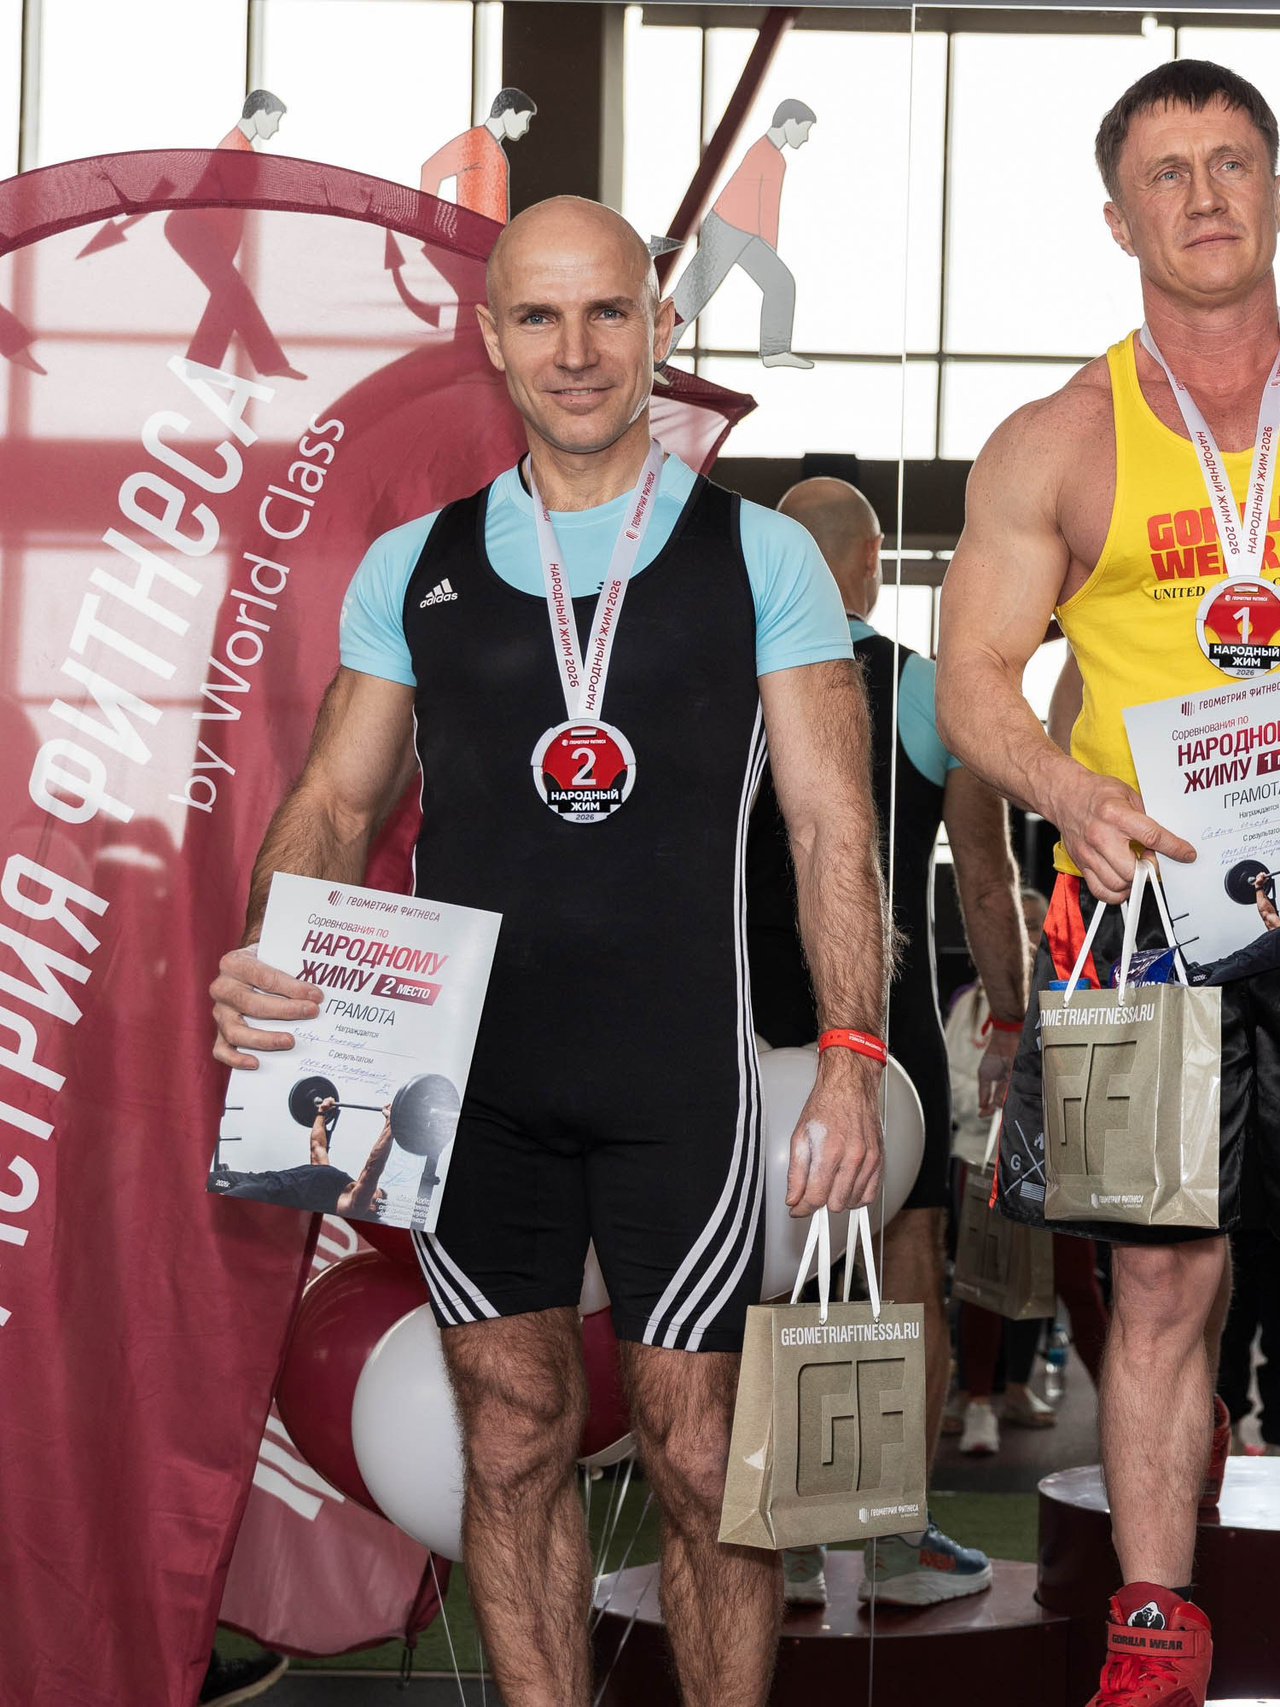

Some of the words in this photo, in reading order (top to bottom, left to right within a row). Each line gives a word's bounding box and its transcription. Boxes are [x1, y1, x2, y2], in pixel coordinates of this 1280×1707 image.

[1261, 426, 1273, 452] 2026
[257, 412, 345, 541] Class
[1257, 453, 1269, 482] ЖИМ
[1196, 431, 1226, 493] НАРОДНЫЙ
[1216, 495, 1233, 524] ЖИМ
[1225, 526, 1240, 555] 2026
[1247, 483, 1265, 554] НАРОДНЫЙ
[1150, 535, 1280, 581] WER
[420, 592, 458, 609] adidas
[549, 562, 570, 626] НАРОДНЫЙ
[1154, 585, 1206, 600] UNITED
[192, 552, 290, 721] World
[1232, 606, 1250, 644] 1
[559, 628, 574, 657] ЖИМ
[585, 638, 607, 711] НАРОДНЫЙ
[600, 607, 614, 637] ЖИМ
[607, 580, 622, 606] 2026
[1213, 645, 1280, 657] НАРОДНЫЙ
[565, 659, 580, 688] 2026
[1232, 657, 1260, 667] ЖИМ
[1171, 718, 1236, 741] Соревнования
[1237, 715, 1249, 727] по
[168, 740, 236, 813] by
[571, 747, 597, 786] 2
[1183, 756, 1252, 794] ЖИМУ
[1264, 756, 1273, 771] 1
[551, 788, 619, 802] НАРОДНЫЙ
[571, 802, 600, 811] ЖИМ
[1238, 803, 1280, 819] Награждается
[307, 913, 375, 936] Соревнования
[376, 927, 389, 938] по
[301, 930, 450, 976] НАРОДНОМУ
[296, 959, 375, 993] ЖИМУ
[380, 977, 397, 995] 2
[396, 983, 431, 999] МЕСТО
[325, 999, 396, 1026] ГРАМОТА
[335, 1024, 380, 1039] Награждается
[334, 1051, 375, 1064] результатом
[1010, 1154, 1022, 1171] G
[781, 1322, 920, 1346] GEOMETRIAFITNESSA.RU
[1111, 1634, 1146, 1648] GORILLA
[1149, 1639, 1183, 1651] WEAR
